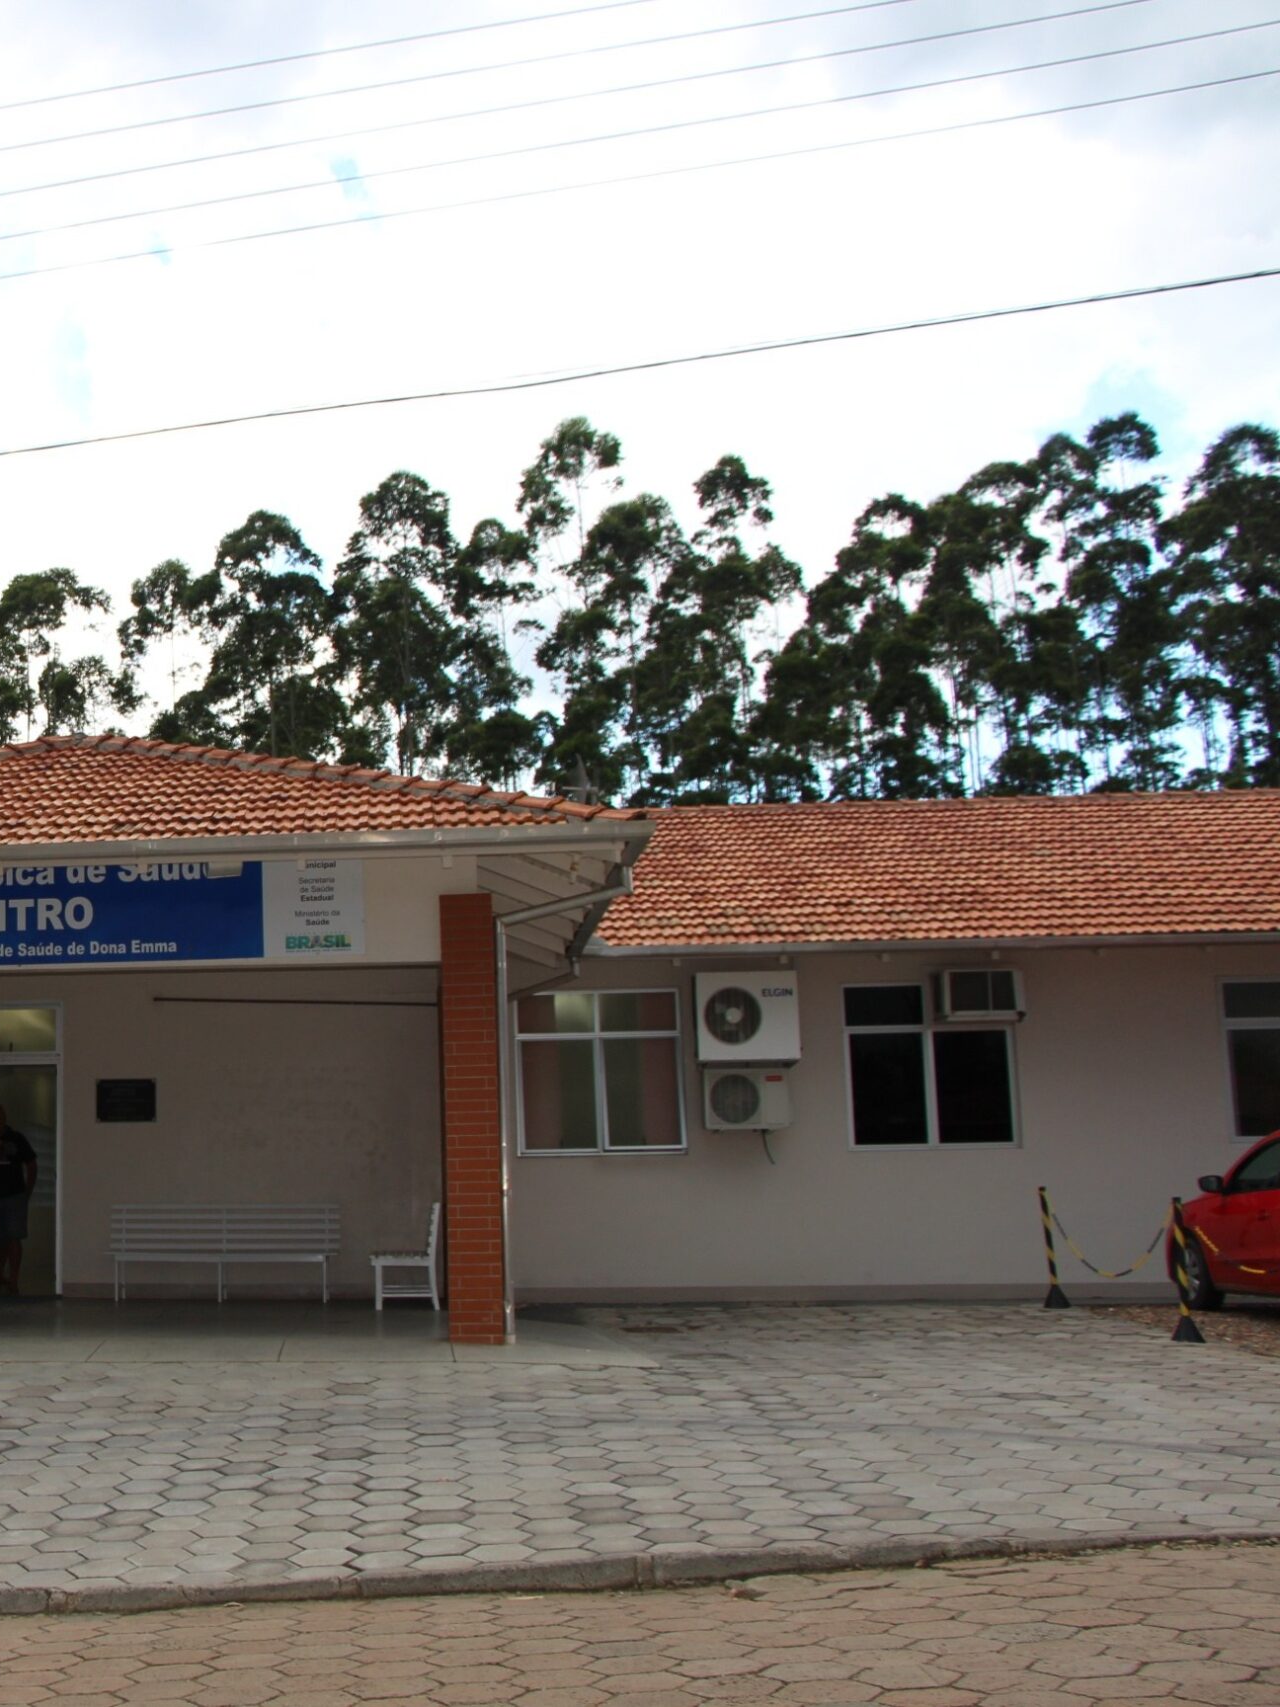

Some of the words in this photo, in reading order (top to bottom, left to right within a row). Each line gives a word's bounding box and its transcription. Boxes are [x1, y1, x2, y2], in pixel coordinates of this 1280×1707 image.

[66, 864, 107, 884] de
[300, 894, 334, 902] Estadual
[18, 942, 62, 957] Saúde
[67, 941, 85, 956] de
[89, 941, 127, 955] Dona
[131, 939, 177, 954] Emma
[285, 934, 352, 949] BRASIL
[762, 987, 793, 997] ELGIN
